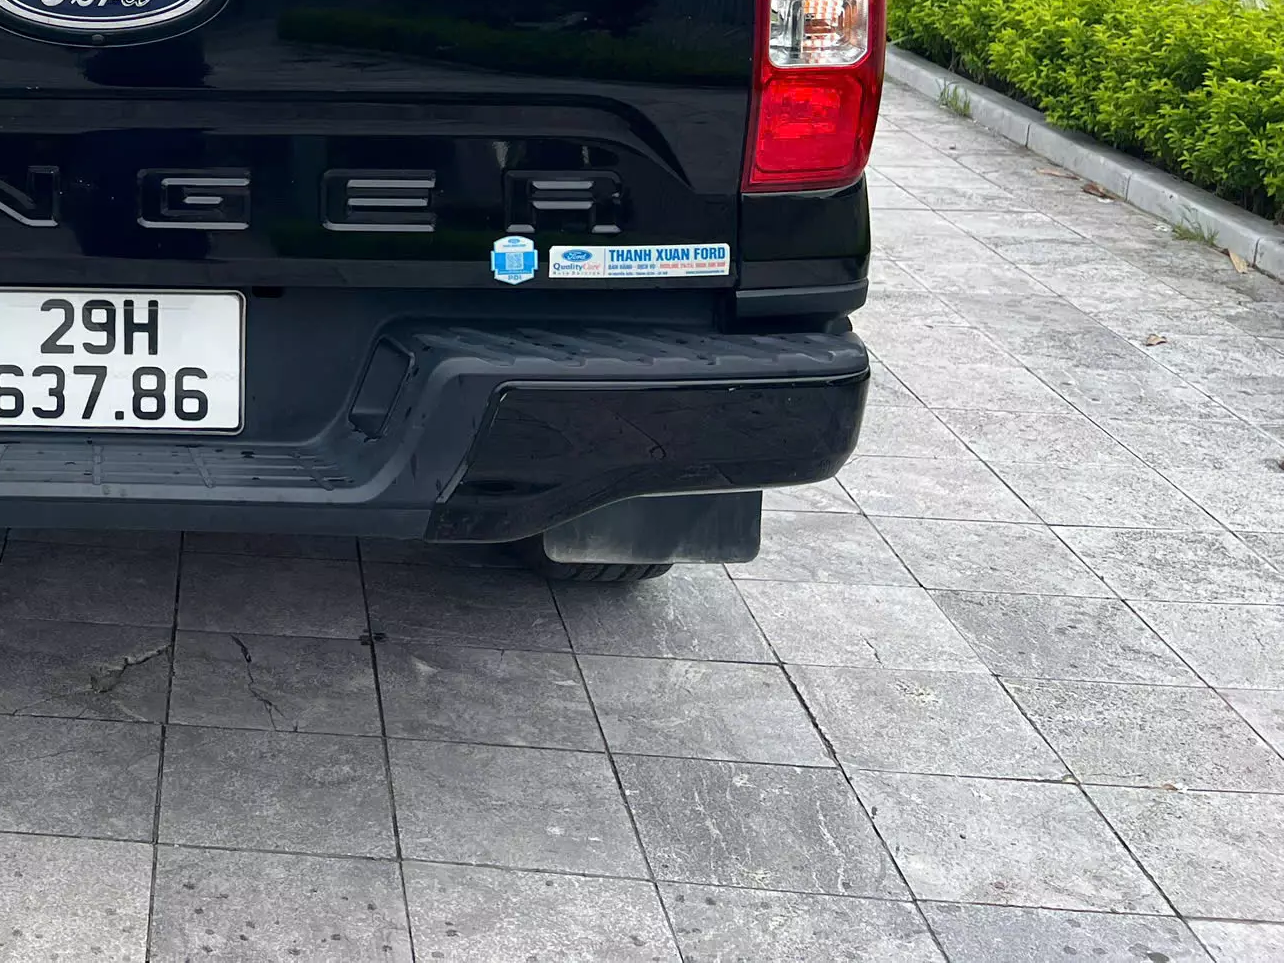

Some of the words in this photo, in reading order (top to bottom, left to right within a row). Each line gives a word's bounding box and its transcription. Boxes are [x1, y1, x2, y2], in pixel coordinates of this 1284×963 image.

[608, 249, 652, 262] THANH
[656, 248, 690, 261] XUAN
[694, 246, 726, 260] FORD
[40, 298, 158, 355] 29H
